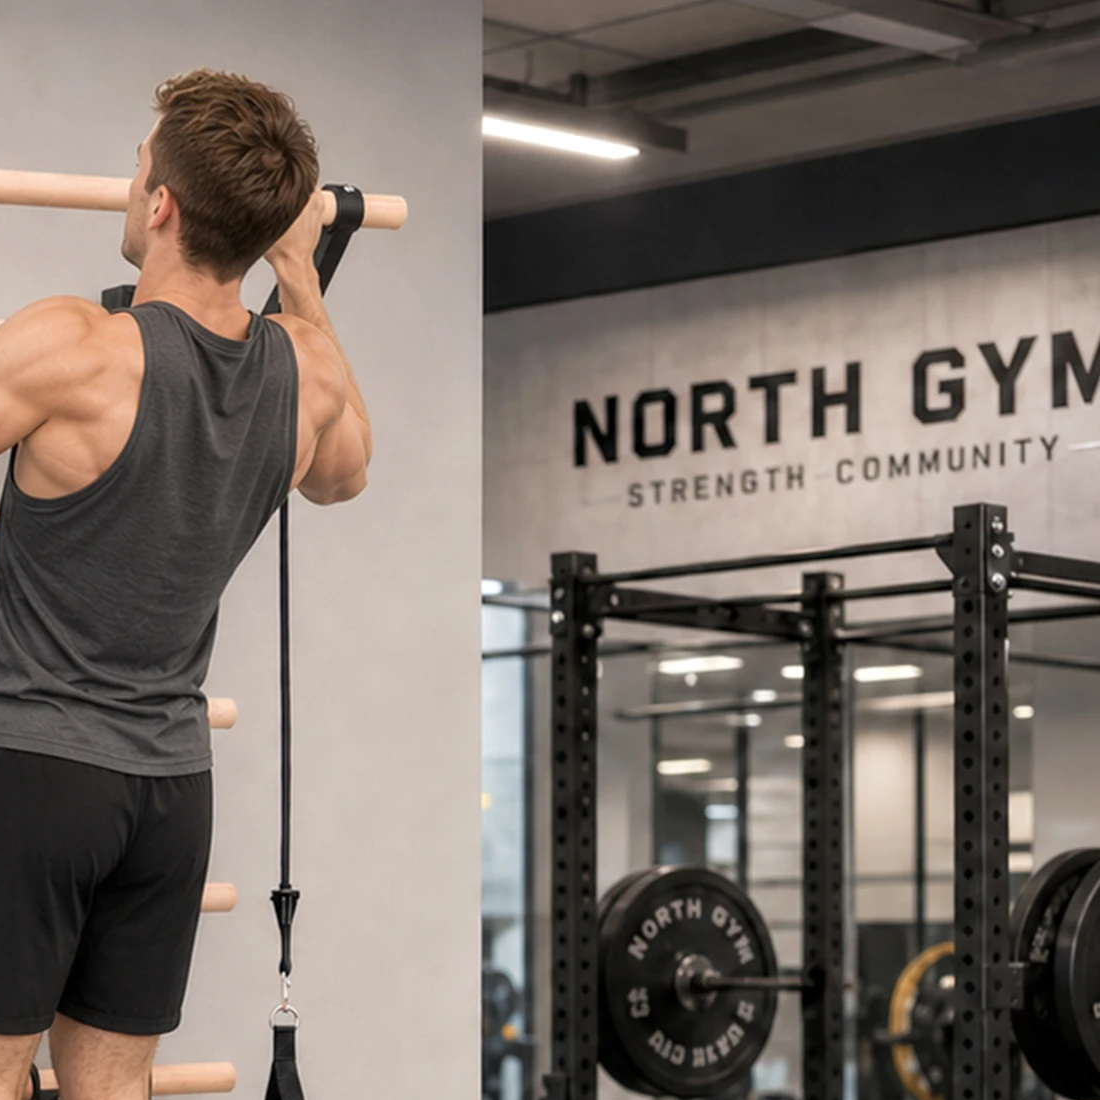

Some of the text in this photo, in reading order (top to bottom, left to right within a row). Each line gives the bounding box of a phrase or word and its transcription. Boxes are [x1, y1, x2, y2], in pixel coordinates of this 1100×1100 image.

[572, 331, 1100, 468] NORTH GYM
[627, 435, 1060, 508] STRENGTH COMMUNITY
[628, 898, 702, 960] NORTH
